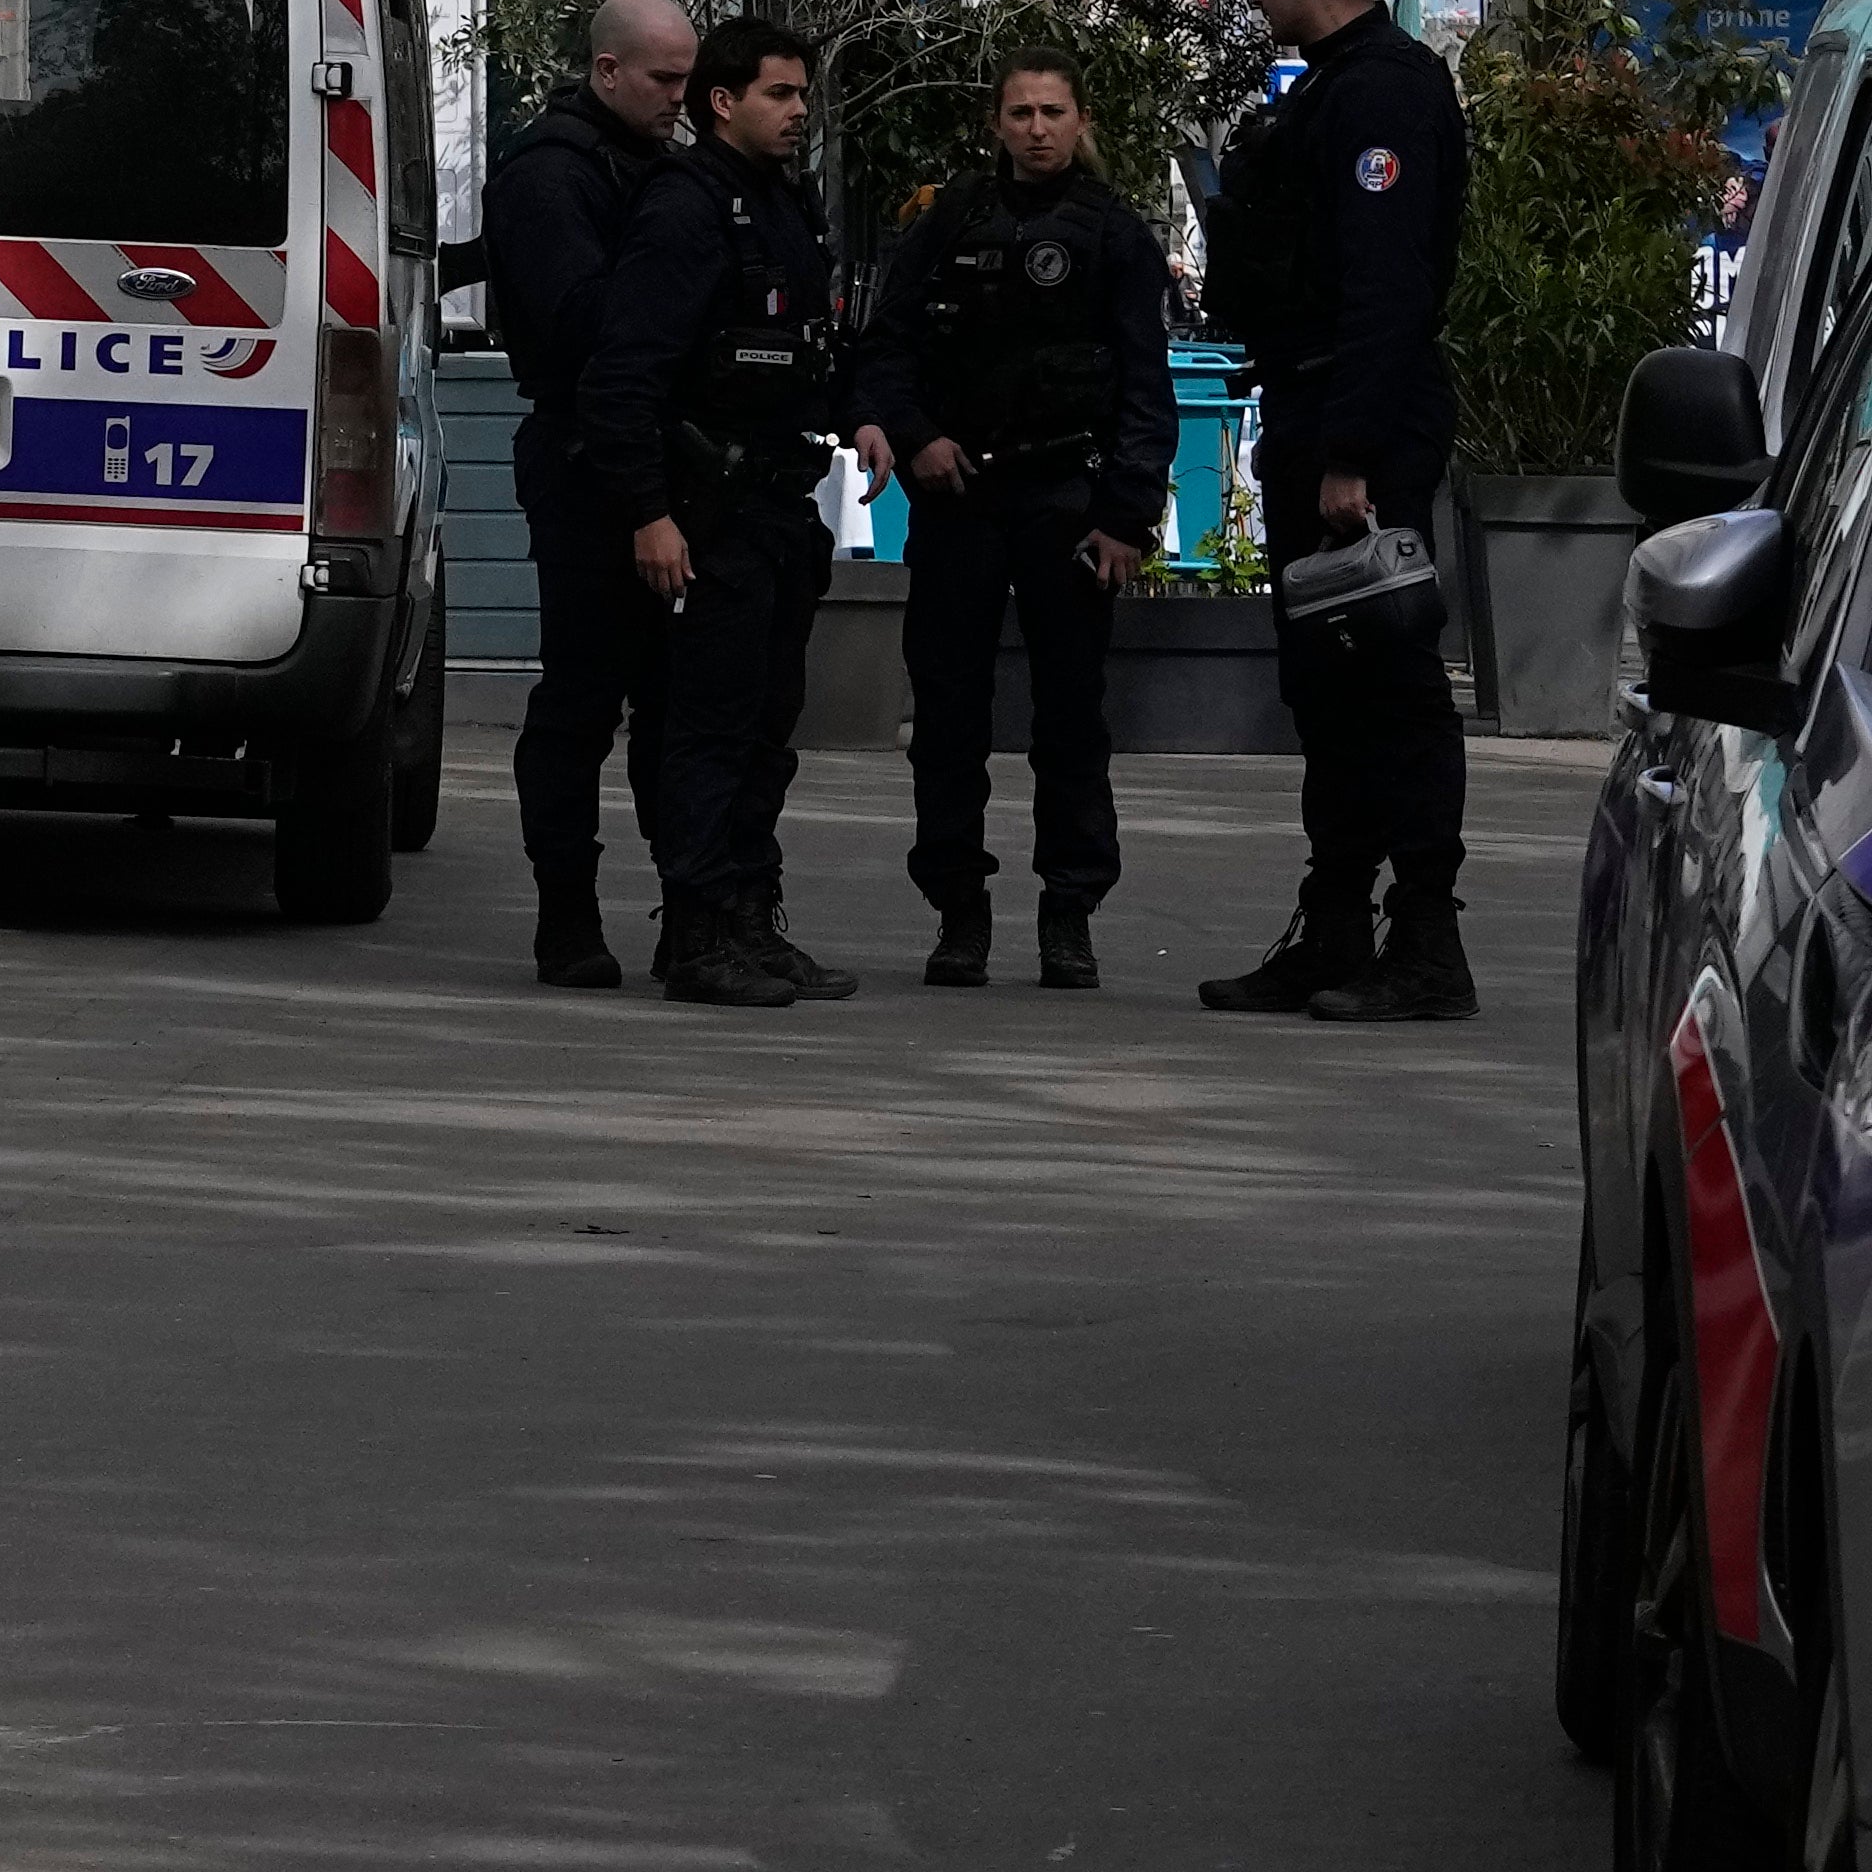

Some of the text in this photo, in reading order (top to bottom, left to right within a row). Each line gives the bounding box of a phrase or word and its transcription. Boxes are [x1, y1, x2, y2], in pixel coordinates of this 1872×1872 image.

[134, 273, 180, 292] Ford
[739, 351, 789, 361] POLICE
[144, 442, 215, 487] 17
